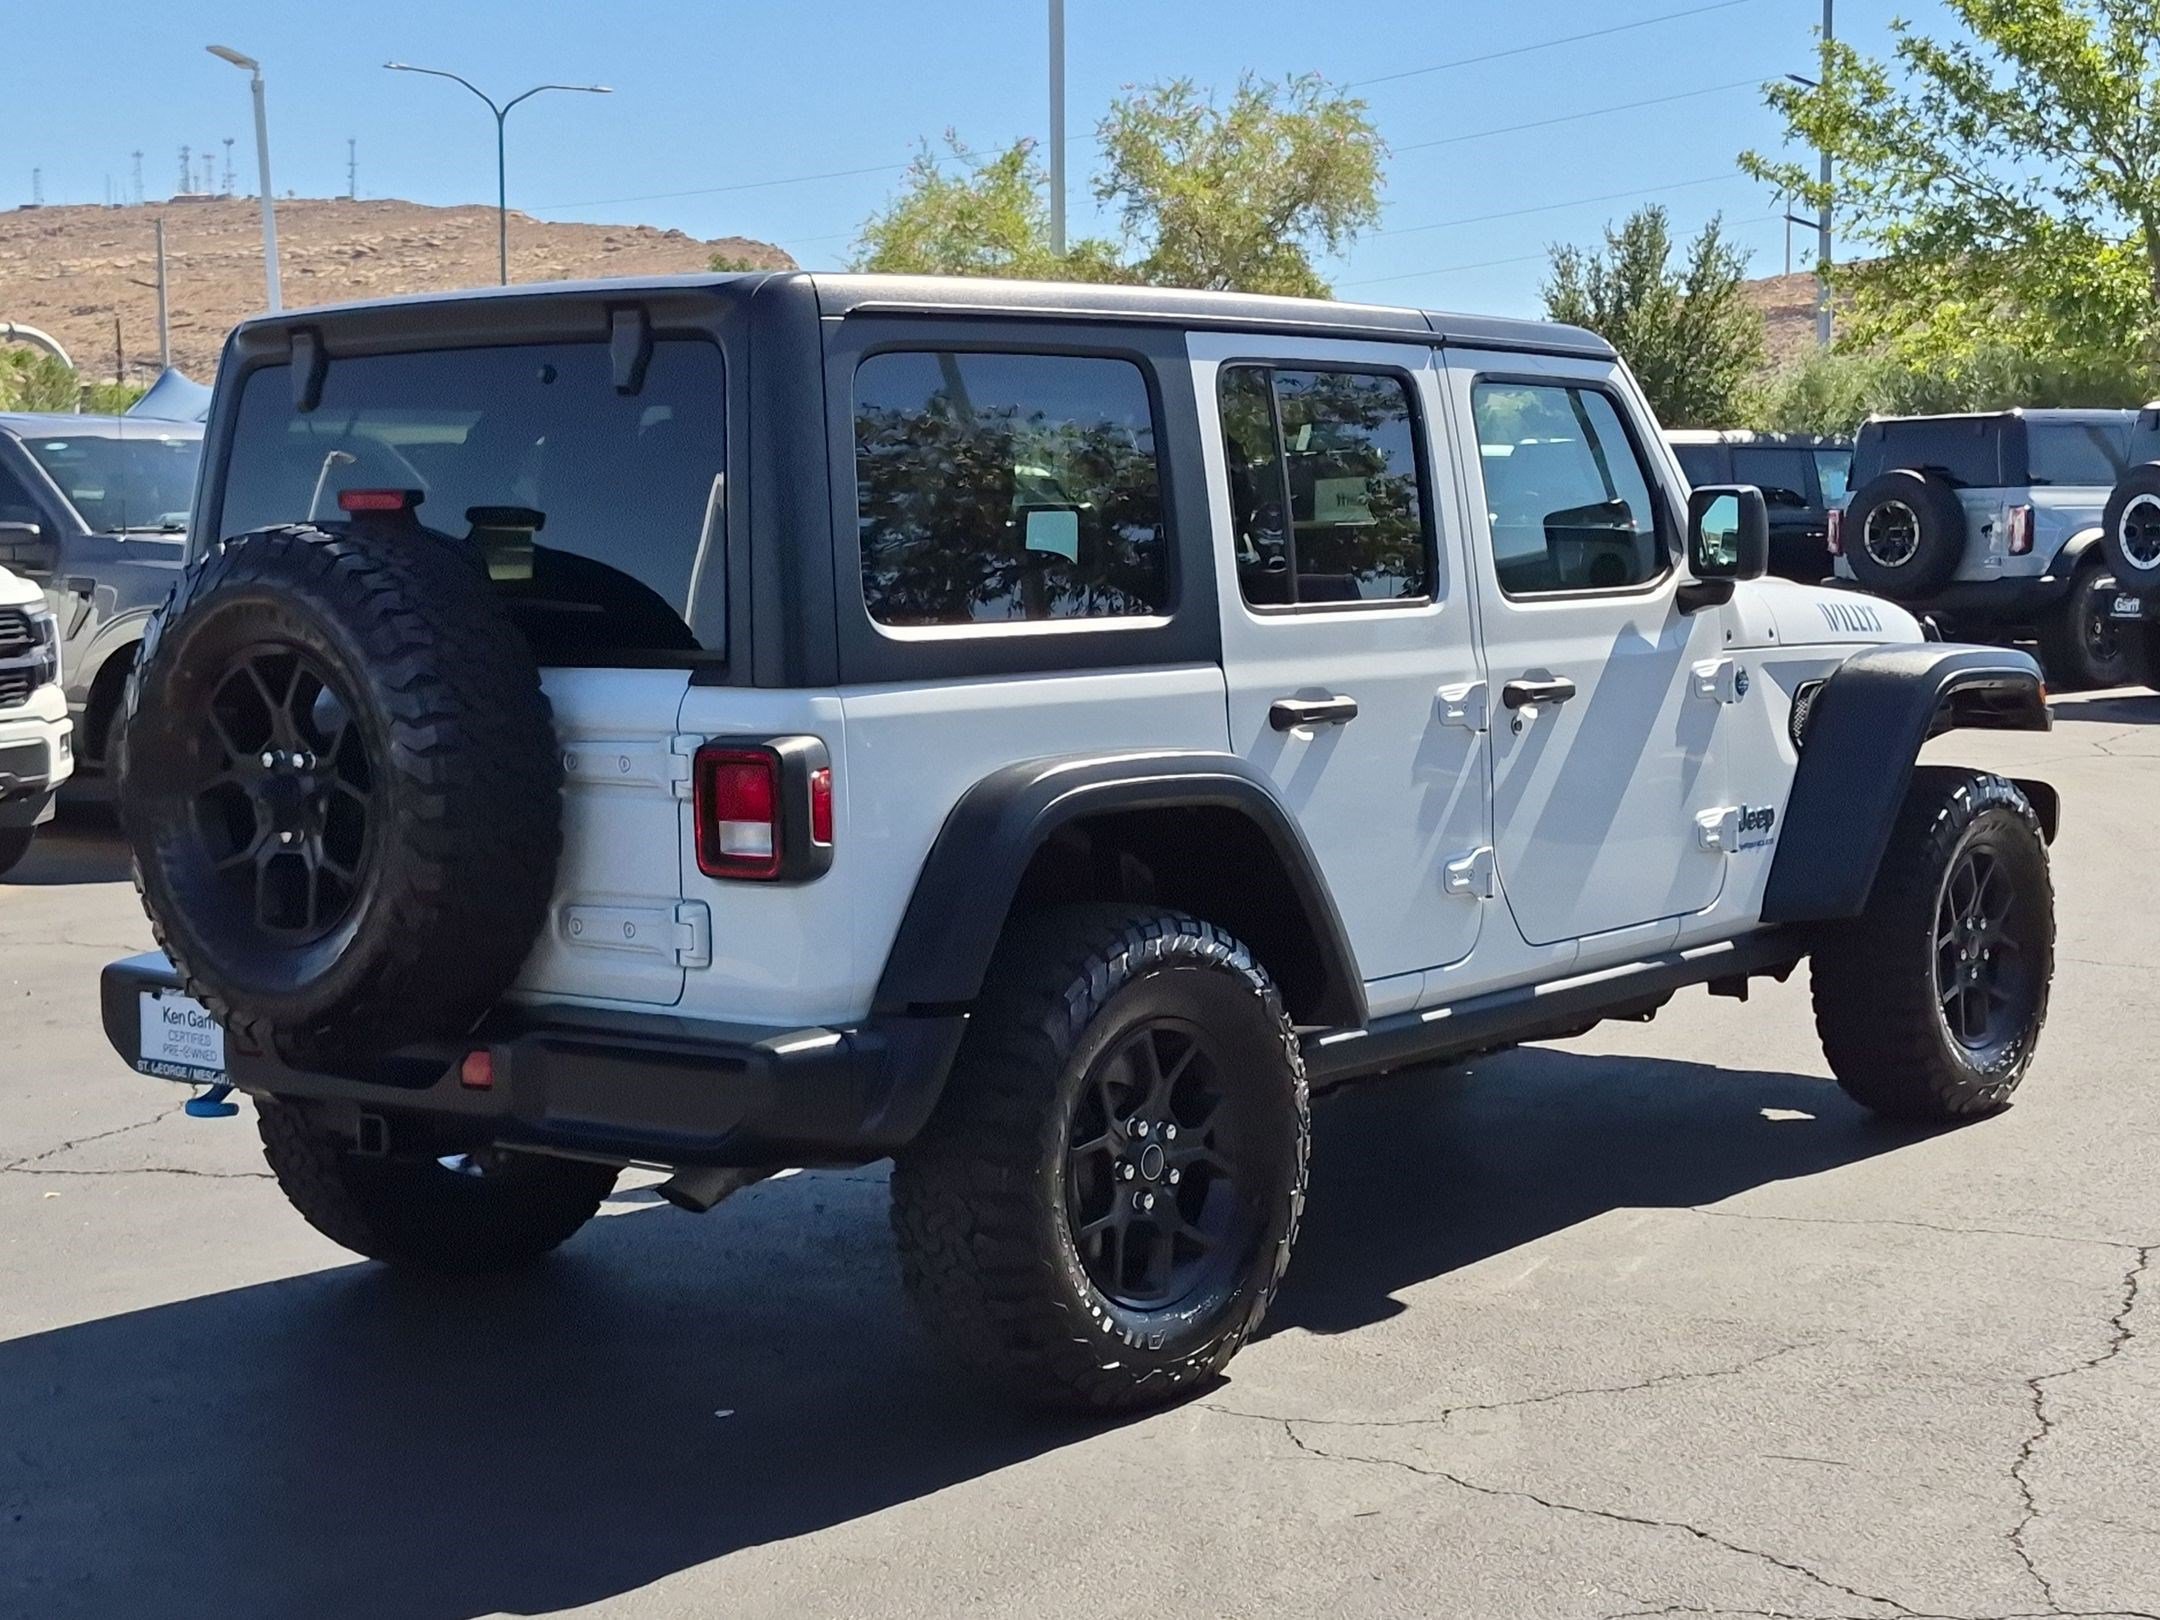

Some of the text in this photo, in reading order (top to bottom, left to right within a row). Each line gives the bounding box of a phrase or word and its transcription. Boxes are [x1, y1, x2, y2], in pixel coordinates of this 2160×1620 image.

[1738, 804, 1775, 833] Jeep
[162, 1006, 186, 1026] Ken
[168, 1029, 212, 1047] CERTIFIED
